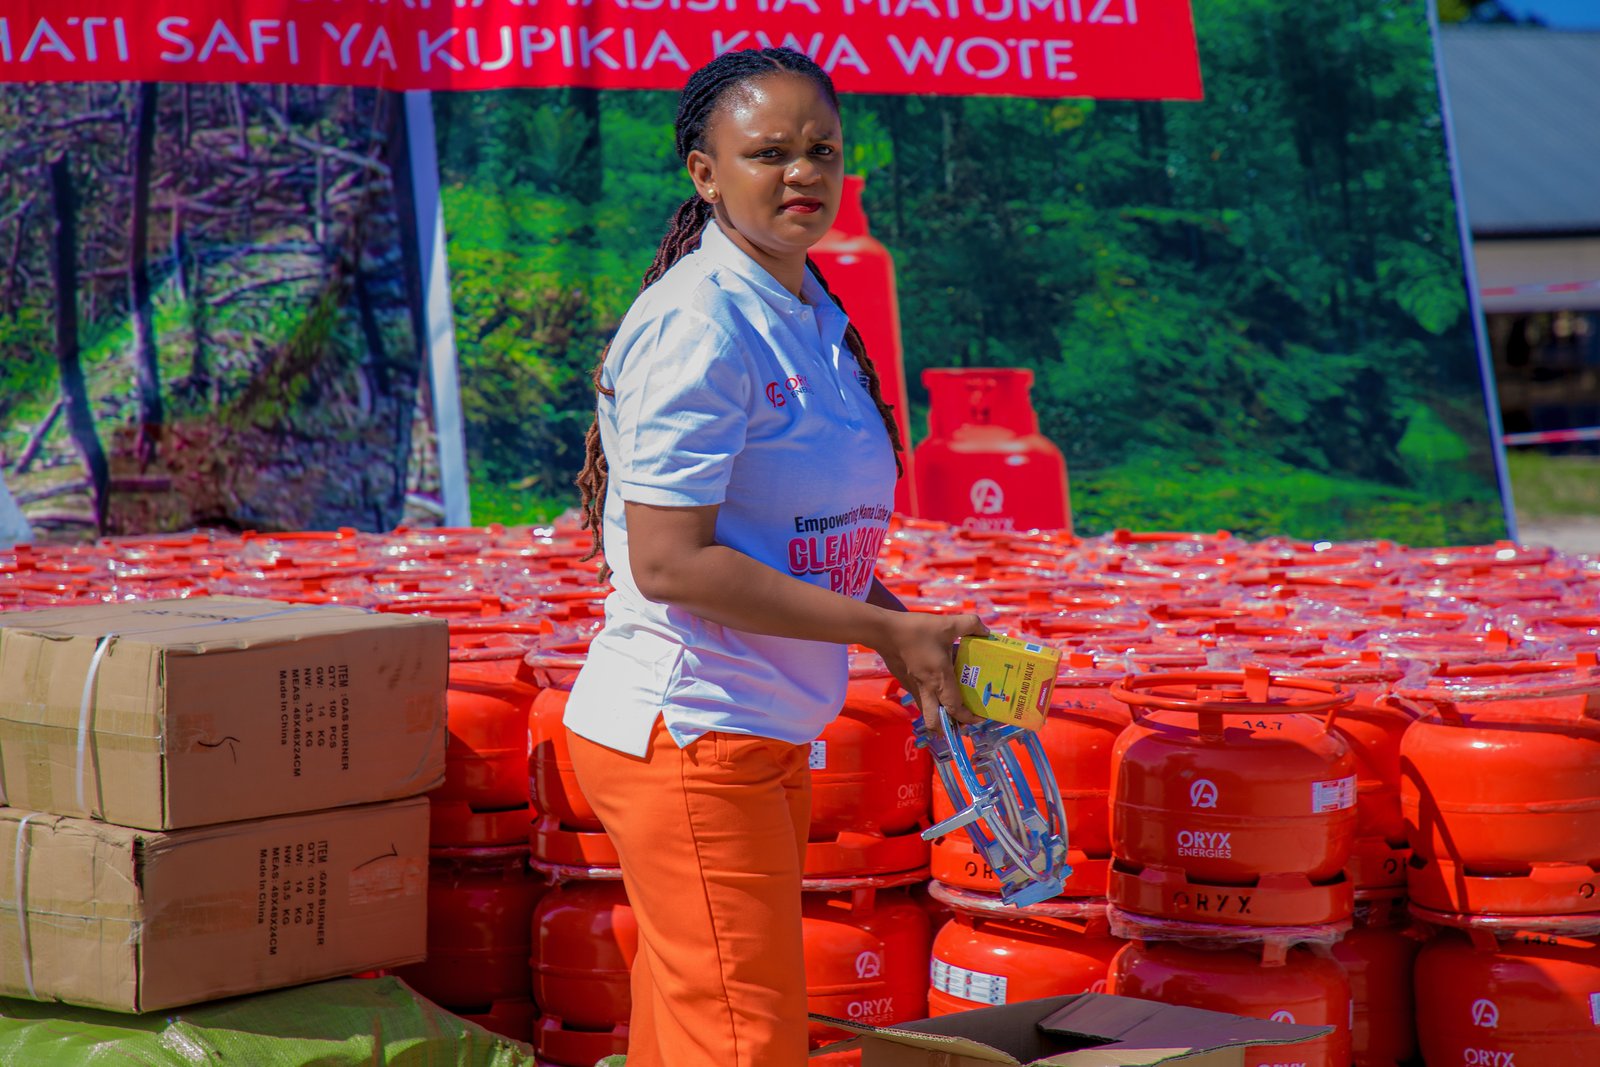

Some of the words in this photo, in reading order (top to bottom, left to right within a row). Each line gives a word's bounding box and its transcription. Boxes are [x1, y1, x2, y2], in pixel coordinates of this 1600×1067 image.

[156, 16, 299, 65] SAFI
[322, 22, 397, 70] YA
[418, 25, 691, 72] KUPIKIA
[886, 34, 1078, 81] WOTE
[316, 666, 324, 689] GW:
[328, 665, 336, 691] QTY:
[338, 665, 348, 688] ITEM
[961, 664, 971, 685] SKY
[1023, 662, 1035, 681] VALVE
[292, 669, 300, 704] MEAS:
[1020, 681, 1030, 695] AND
[318, 705, 325, 717] 14
[329, 700, 337, 718] 100
[1014, 695, 1027, 720] BURNER
[280, 714, 289, 745] China
[1242, 720, 1283, 731] 14.7
[306, 731, 313, 747] KG
[318, 730, 325, 747] KG
[329, 726, 337, 749] PCS
[341, 724, 349, 771] BURNER
[1177, 830, 1232, 849] ORYX
[284, 845, 292, 868] NW:
[295, 843, 303, 866] GW:
[307, 842, 315, 868] QTY:
[317, 840, 328, 863] ITEM
[1177, 847, 1232, 859] ENERGIES
[259, 849, 267, 878] Made
[271, 847, 279, 882] MEAS:
[283, 880, 291, 901] 13.5
[295, 880, 303, 893] 14
[258, 893, 266, 925] China
[306, 902, 314, 925] PCS
[1173, 891, 1252, 914] ORYX
[282, 908, 290, 925] KG
[294, 907, 302, 924] KG
[317, 899, 326, 946] BURNER
[847, 997, 895, 1018] ORYX
[1463, 1048, 1516, 1067] ORYX
